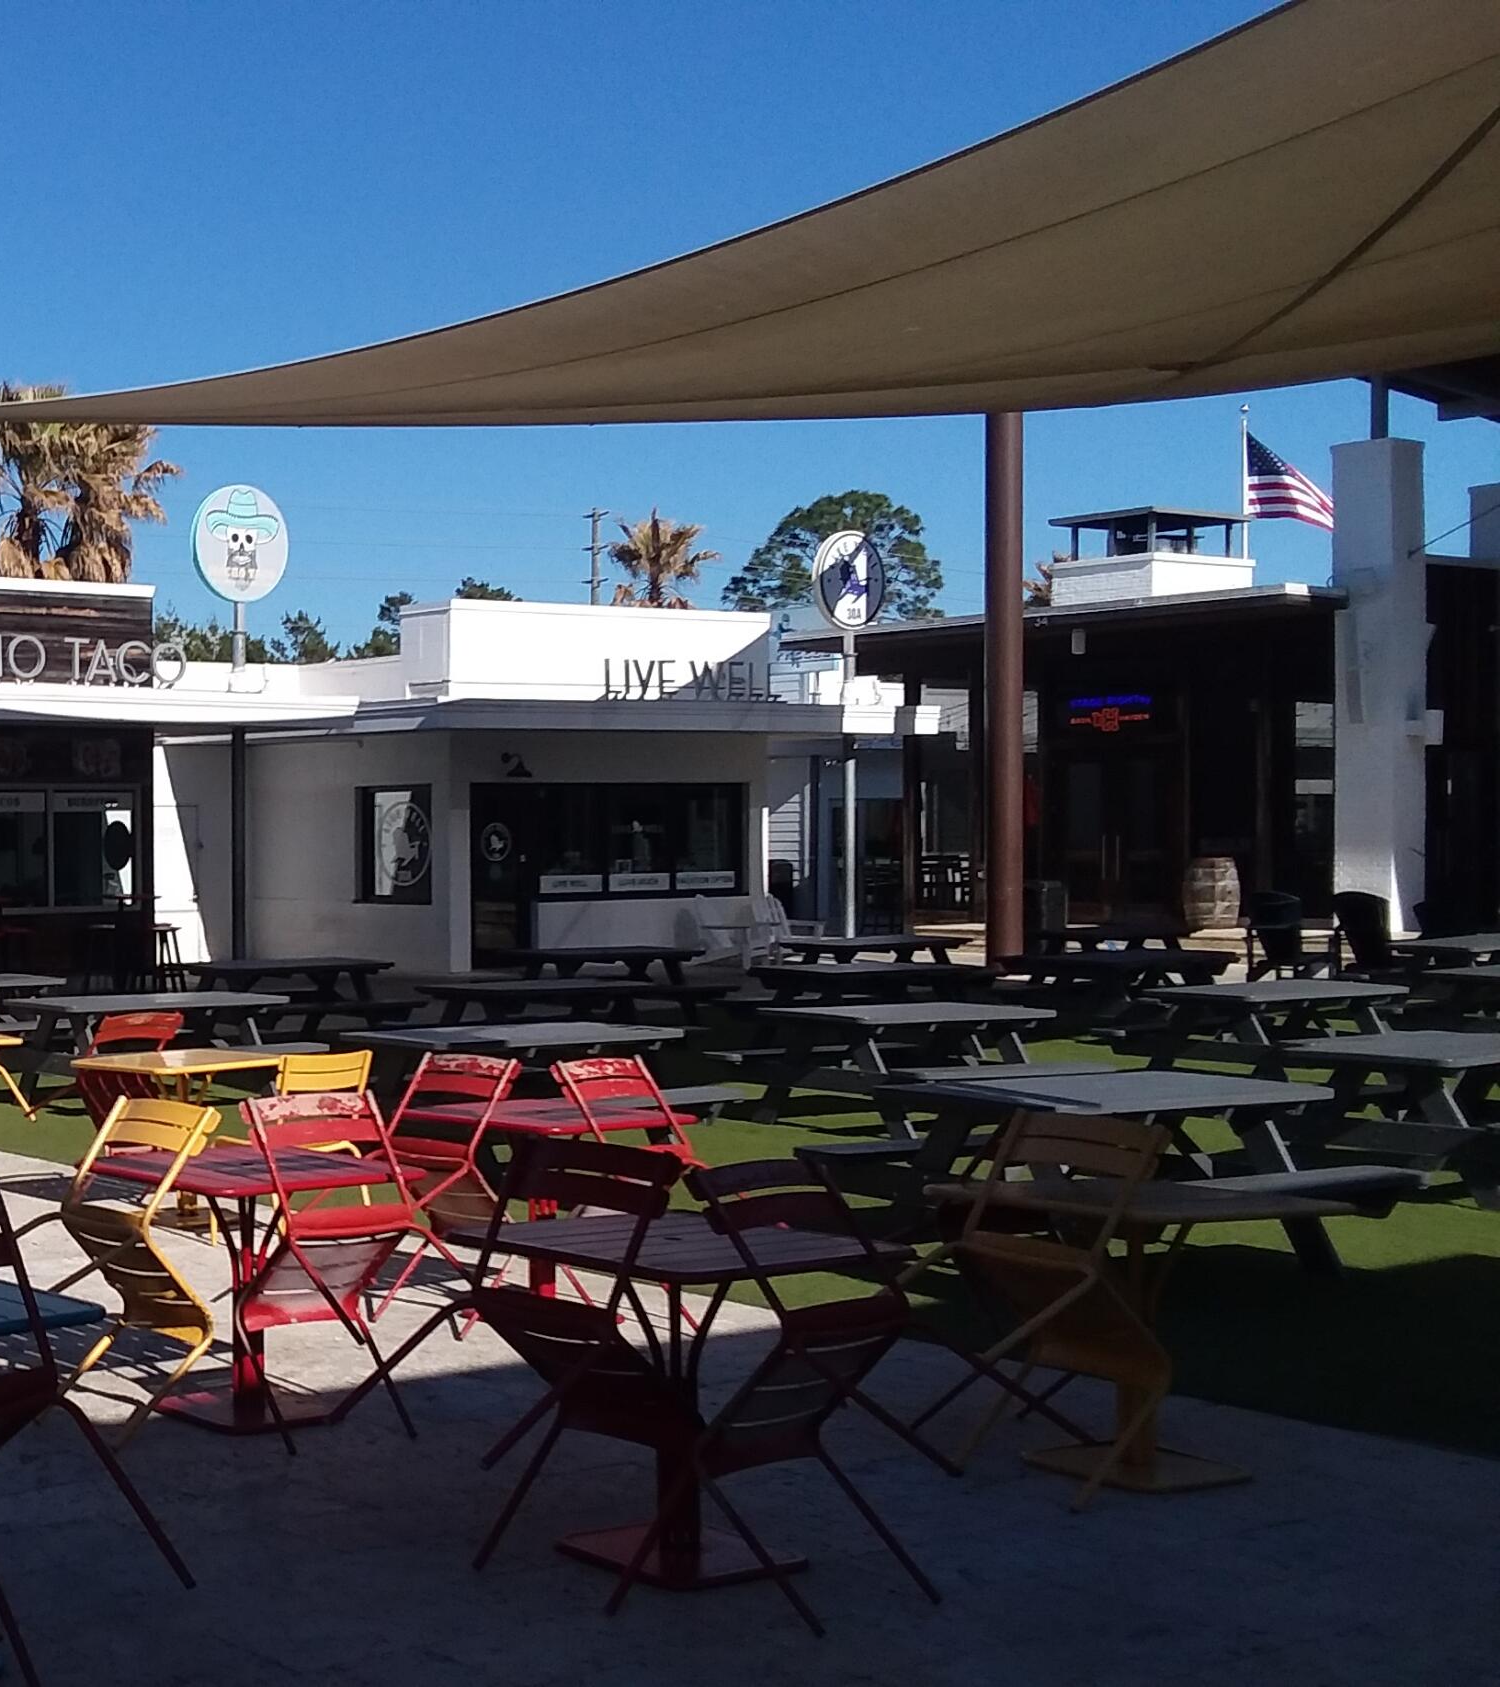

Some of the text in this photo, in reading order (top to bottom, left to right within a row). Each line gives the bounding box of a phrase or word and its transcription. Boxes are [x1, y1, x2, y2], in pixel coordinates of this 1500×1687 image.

[64, 636, 187, 685] TACO
[604, 658, 676, 697] LIVE
[689, 659, 782, 699] WELL
